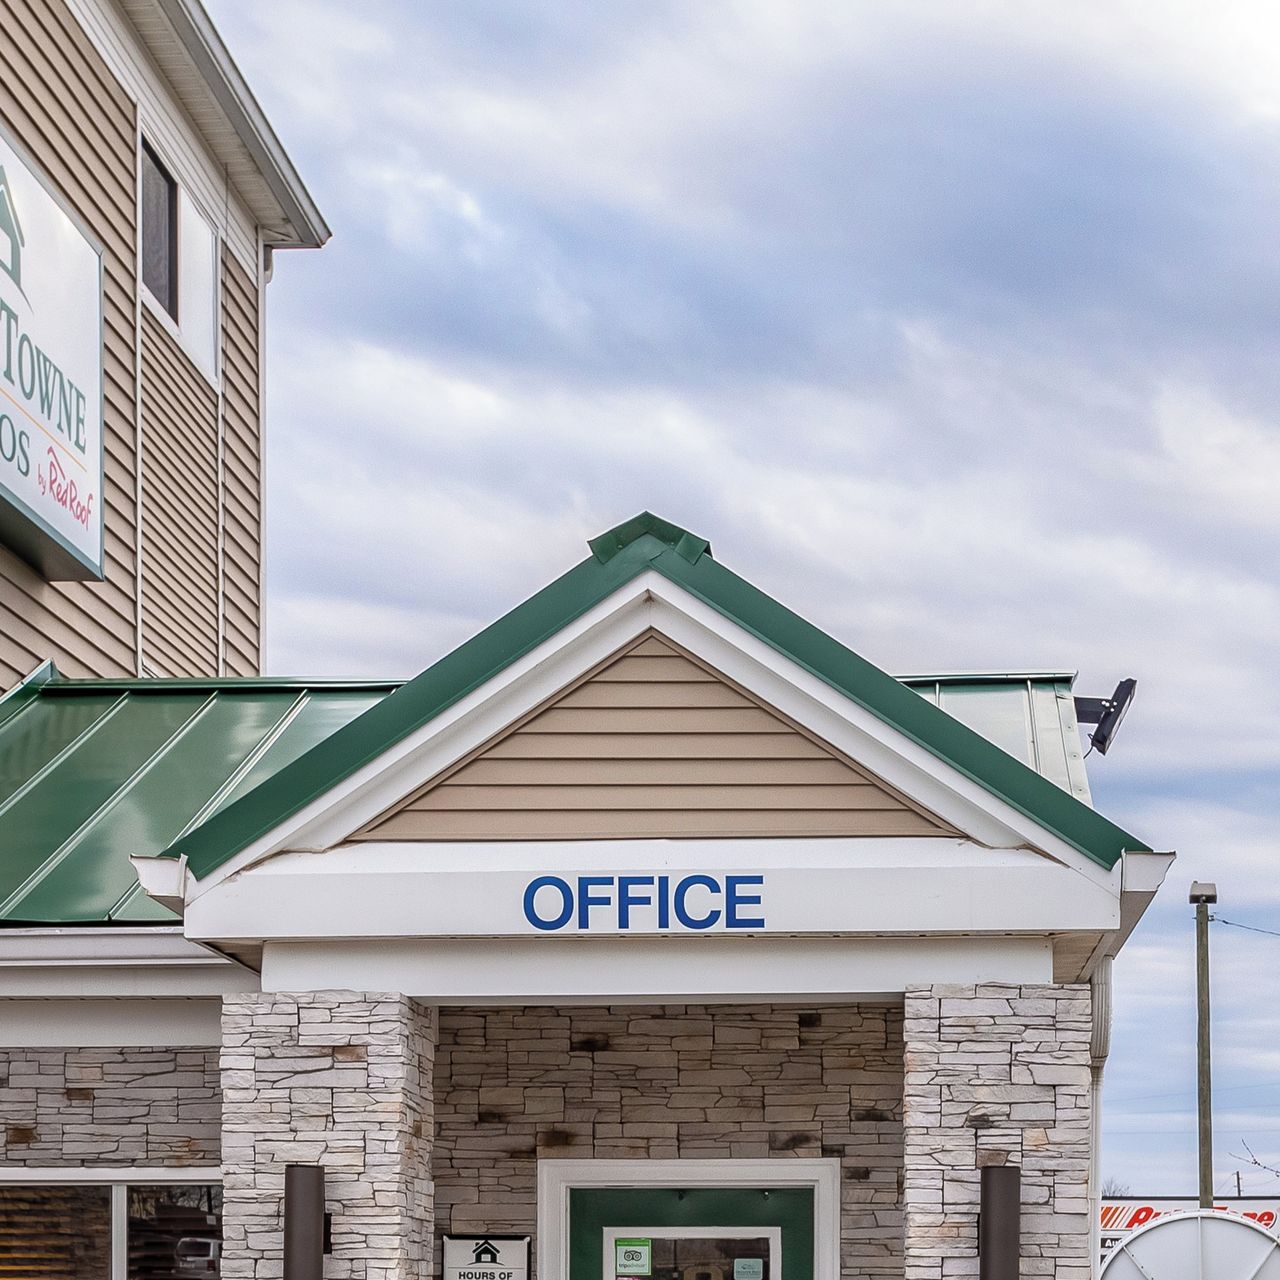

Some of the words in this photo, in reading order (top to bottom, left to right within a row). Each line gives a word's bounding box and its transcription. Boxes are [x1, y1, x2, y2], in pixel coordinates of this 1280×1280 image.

[37, 464, 47, 496] by
[522, 874, 766, 931] OFFICE
[458, 1271, 496, 1280] HOURS
[498, 1271, 514, 1280] OF
